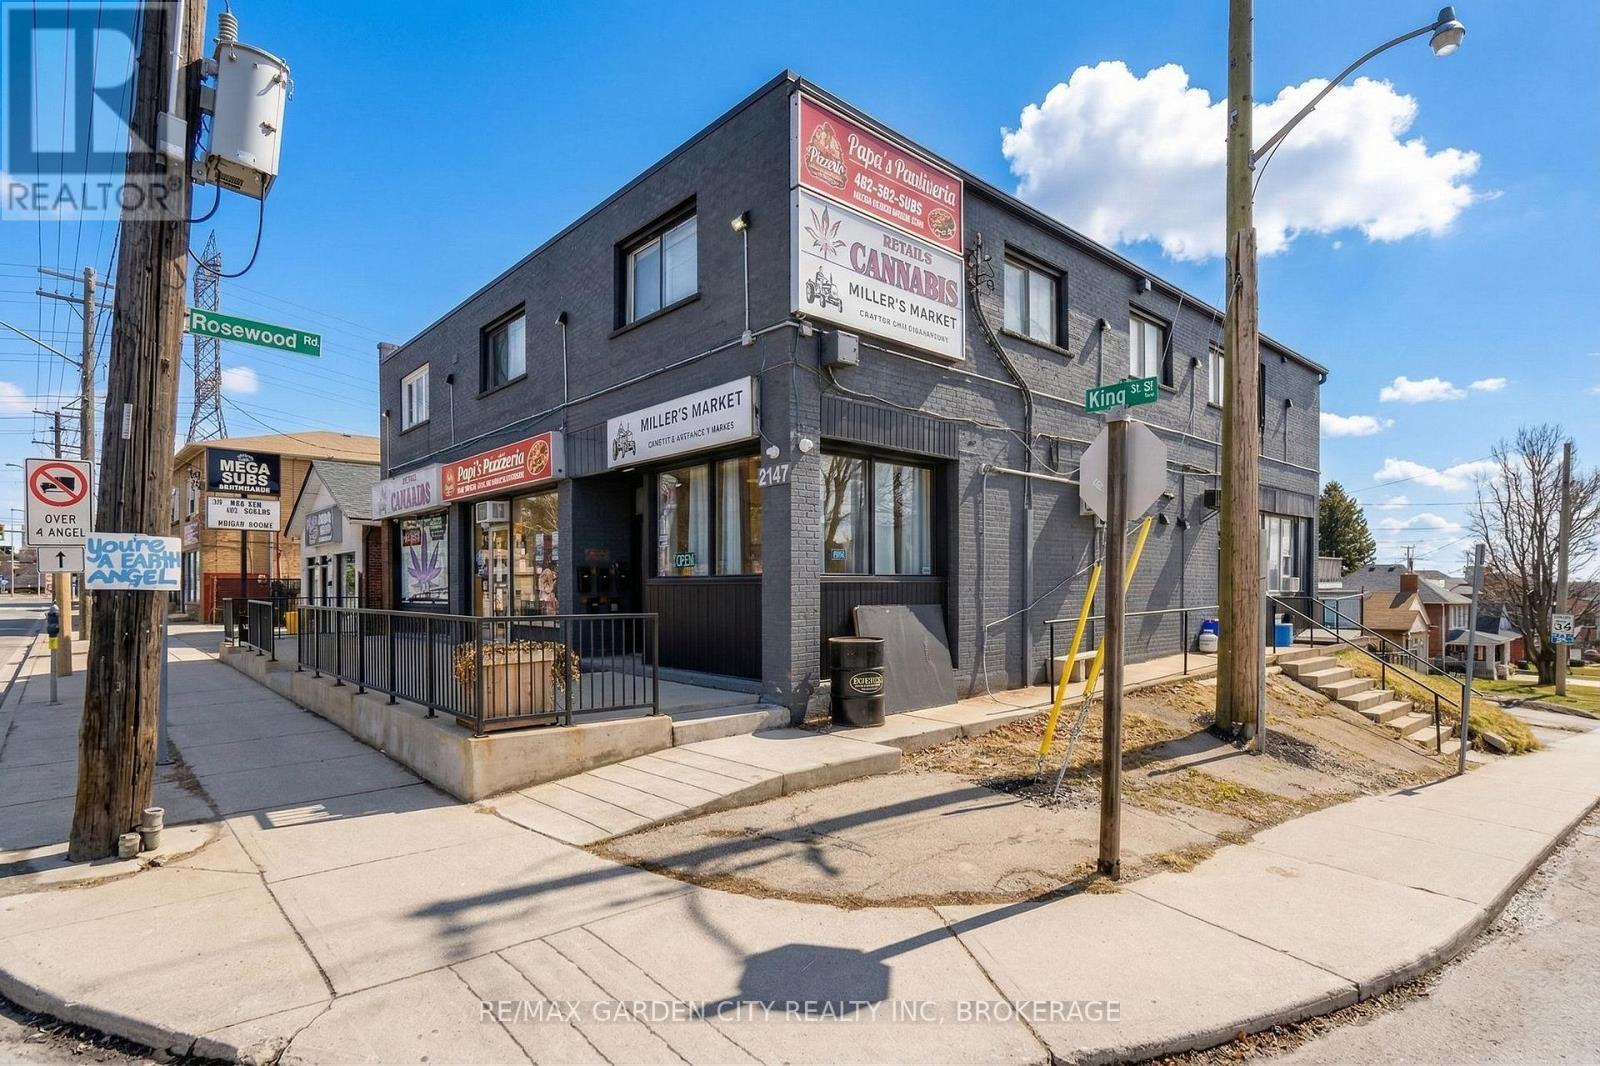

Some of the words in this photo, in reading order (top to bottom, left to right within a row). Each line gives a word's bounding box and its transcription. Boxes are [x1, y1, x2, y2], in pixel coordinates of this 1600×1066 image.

[848, 134, 892, 174] Papa's
[883, 234, 933, 265] RETAILS
[849, 242, 959, 308] CANNABIS
[849, 282, 906, 313] MILLER'S
[910, 303, 957, 329] MARKET
[192, 312, 297, 348] Rosewood
[303, 335, 320, 347] Rd.
[1089, 390, 1126, 408] King
[640, 407, 688, 432] MILLER'S
[692, 390, 743, 418] MARKET
[220, 459, 270, 475] MEGA
[759, 464, 789, 486] 2147
[222, 472, 268, 486] SUBS
[45, 514, 76, 524] OVER
[48, 528, 86, 537] ANGEL
[97, 553, 115, 568] A
[87, 568, 178, 587] ANGEL
